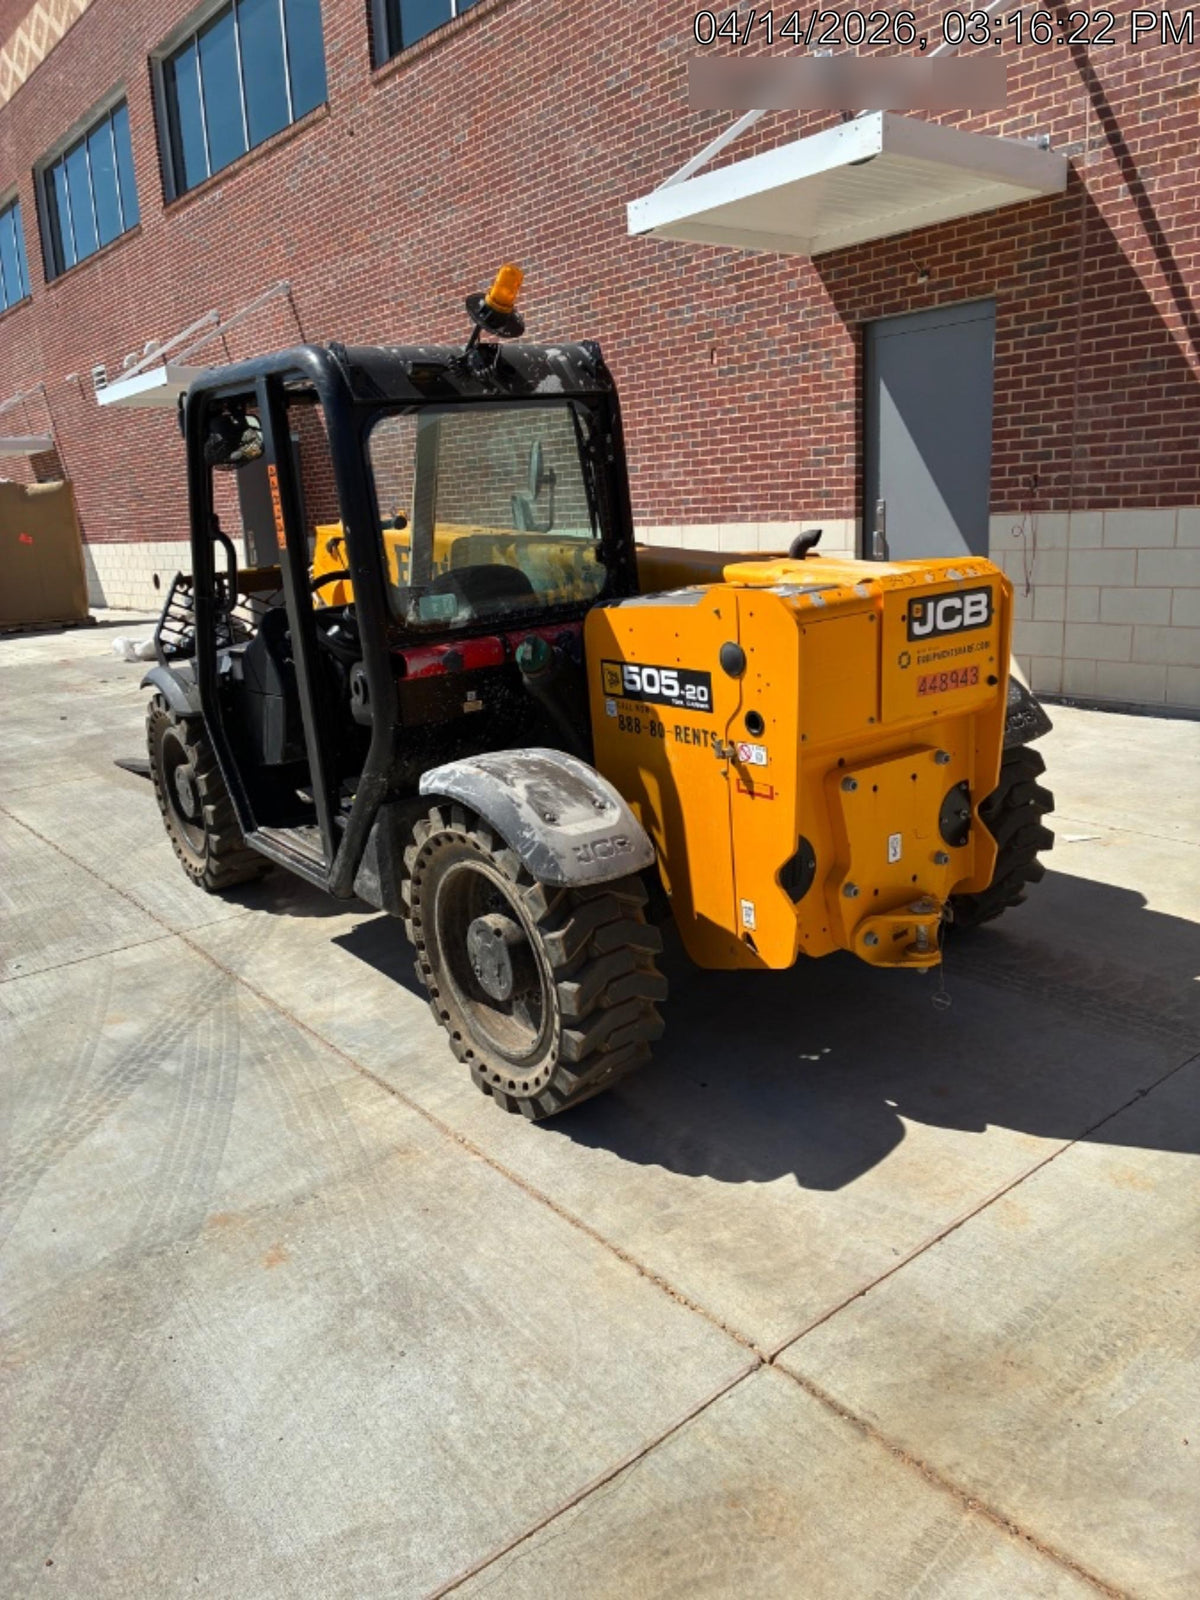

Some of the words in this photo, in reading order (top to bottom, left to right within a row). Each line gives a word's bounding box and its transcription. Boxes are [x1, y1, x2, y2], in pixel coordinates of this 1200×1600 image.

[911, 592, 989, 636] JCB
[918, 665, 980, 695] 448943
[571, 834, 636, 865] JCB
